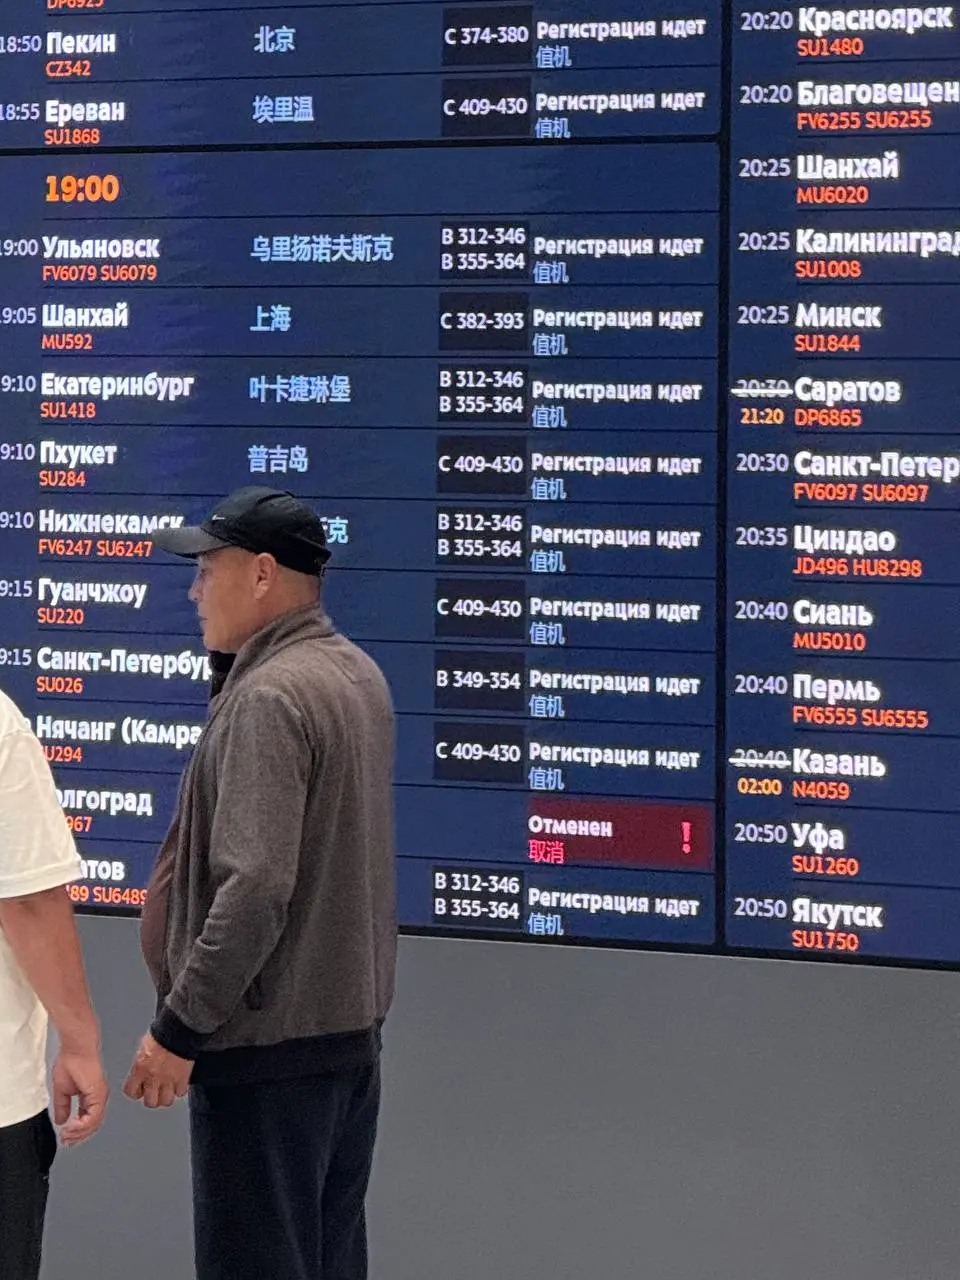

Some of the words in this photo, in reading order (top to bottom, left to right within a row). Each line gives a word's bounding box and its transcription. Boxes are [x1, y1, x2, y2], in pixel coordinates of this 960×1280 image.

[444, 28, 457, 45] C
[460, 25, 529, 45] 374-380
[798, 6, 954, 38] Красноярск
[46, 31, 117, 55] Пекин
[798, 37, 864, 57] SU1480
[45, 60, 91, 77] CZ342
[45, 99, 126, 128] Ереван
[796, 150, 900, 180] Шанхай
[46, 174, 120, 203] 19:00
[796, 185, 869, 204] MU6020
[41, 235, 161, 259] Ульяновск
[41, 301, 129, 328] Шанхай
[249, 304, 292, 332] 上海
[737, 305, 790, 324] 20:25
[794, 302, 882, 329] Минск
[42, 333, 92, 350] MU592
[795, 334, 861, 352] SU1844
[40, 371, 195, 402] Екатеринбург
[794, 376, 902, 408] Саратов
[40, 401, 96, 418] SU1418
[39, 440, 118, 469] Пхукет
[793, 524, 897, 556] Циндао
[37, 577, 148, 609] Гуанчжоу
[37, 607, 85, 625] SU220
[792, 599, 874, 627] Сиань
[793, 673, 881, 706] Пермь
[792, 747, 887, 778] Казань
[527, 814, 613, 838] Отменен
[791, 822, 845, 855] Уфа
[528, 838, 565, 864] 取消
[791, 897, 883, 931] Якутск
[792, 929, 860, 951] SU1750
